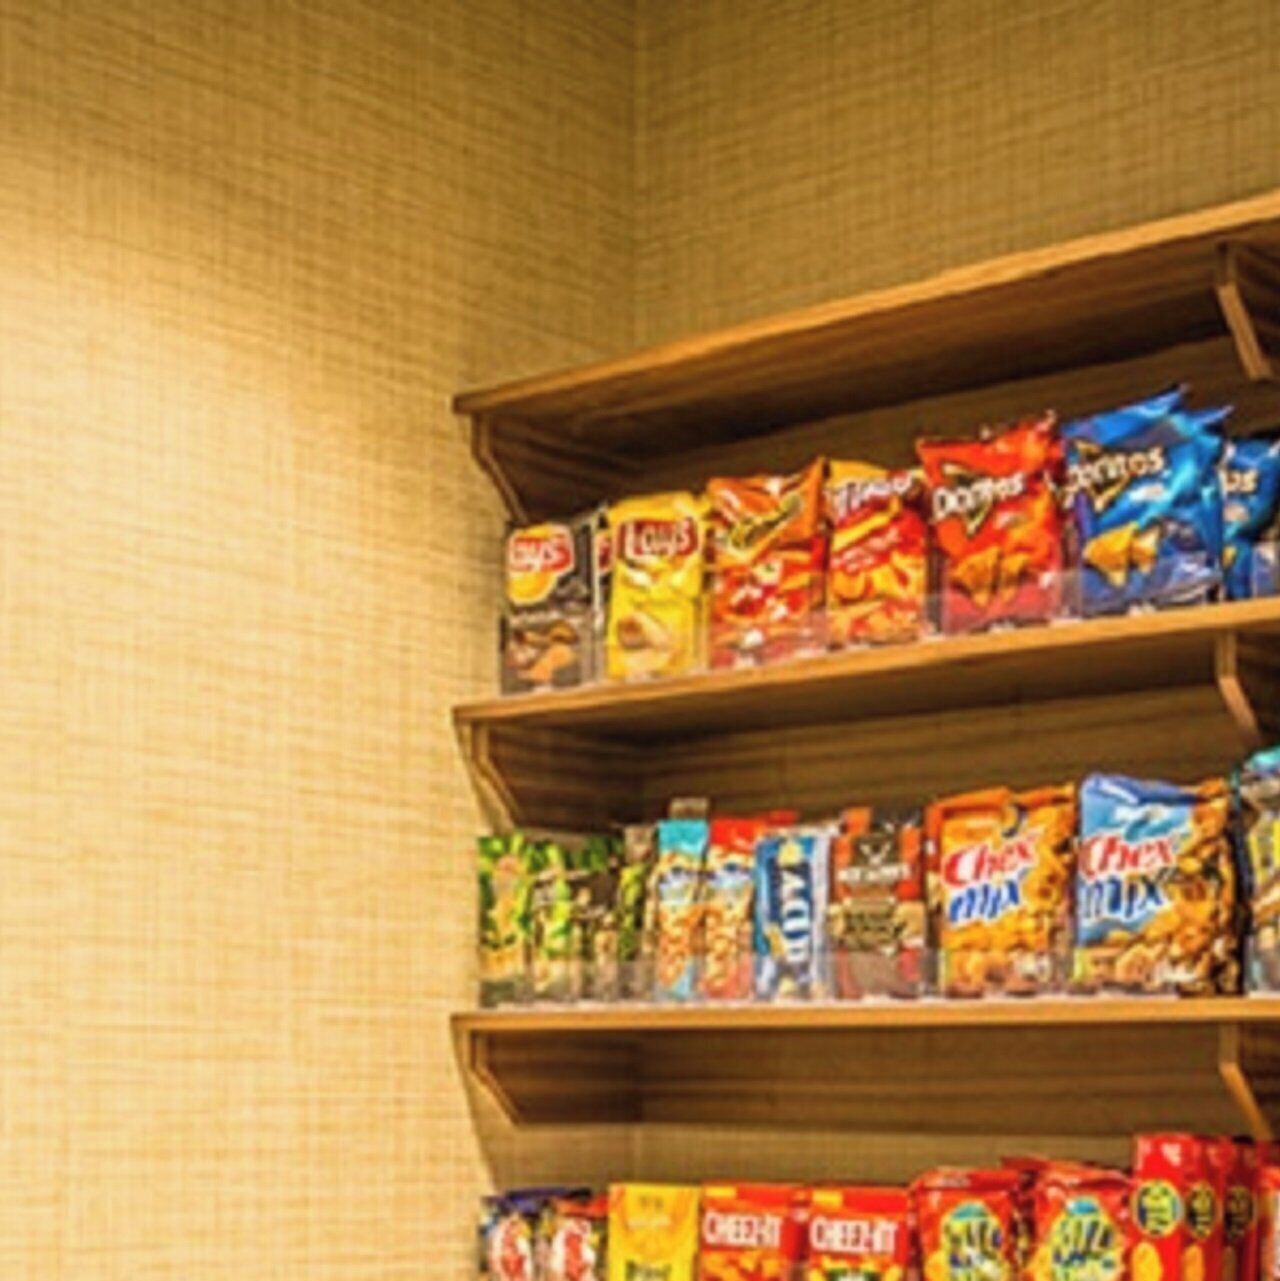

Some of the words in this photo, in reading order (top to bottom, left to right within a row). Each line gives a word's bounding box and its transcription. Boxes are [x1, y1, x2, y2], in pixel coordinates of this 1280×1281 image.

[931, 472, 1026, 521] Doritos
[1063, 444, 1166, 504] Doritos
[944, 834, 1038, 888] Chex
[1081, 835, 1174, 880] Chex
